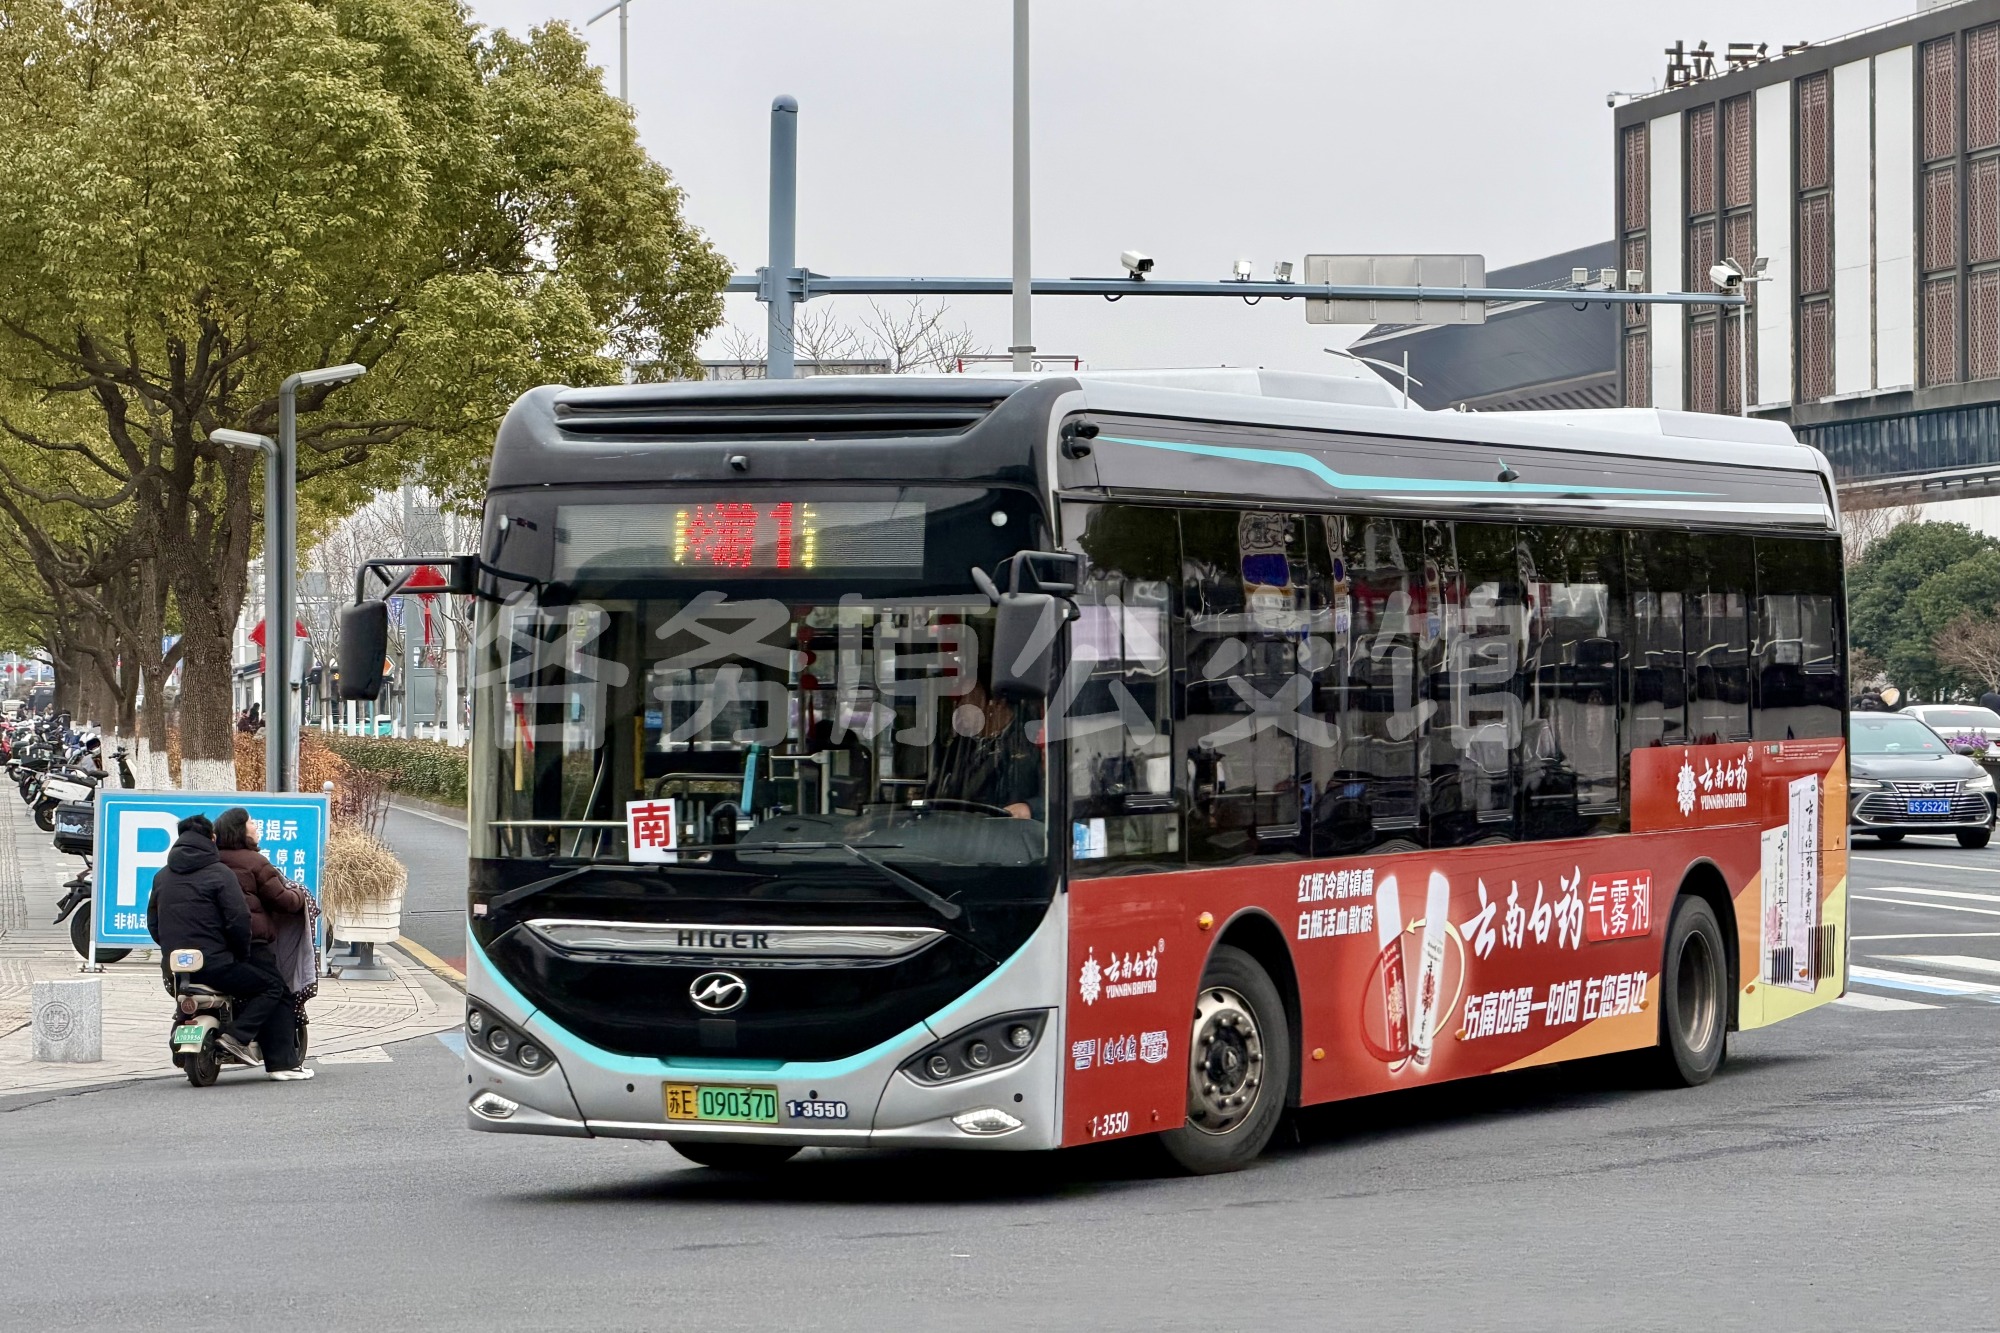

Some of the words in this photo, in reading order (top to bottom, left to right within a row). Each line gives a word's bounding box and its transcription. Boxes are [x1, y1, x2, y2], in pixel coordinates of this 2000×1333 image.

[1698, 754, 1748, 793] 云南白药
[631, 802, 671, 849] 南
[116, 810, 182, 907] P
[1297, 867, 1375, 903] 红瓶冷敷镇痛
[1297, 904, 1374, 940] 白瓶活血散瘀
[1459, 865, 1584, 960] 云南白药
[1588, 876, 1651, 936] 气雾剂
[677, 929, 770, 949] HIGER
[1103, 945, 1159, 983] 云南白药
[1463, 979, 1582, 1041] 伤痛的第一时间
[1582, 970, 1649, 1021] 在您身边
[1092, 1110, 1129, 1138] 1-3550
